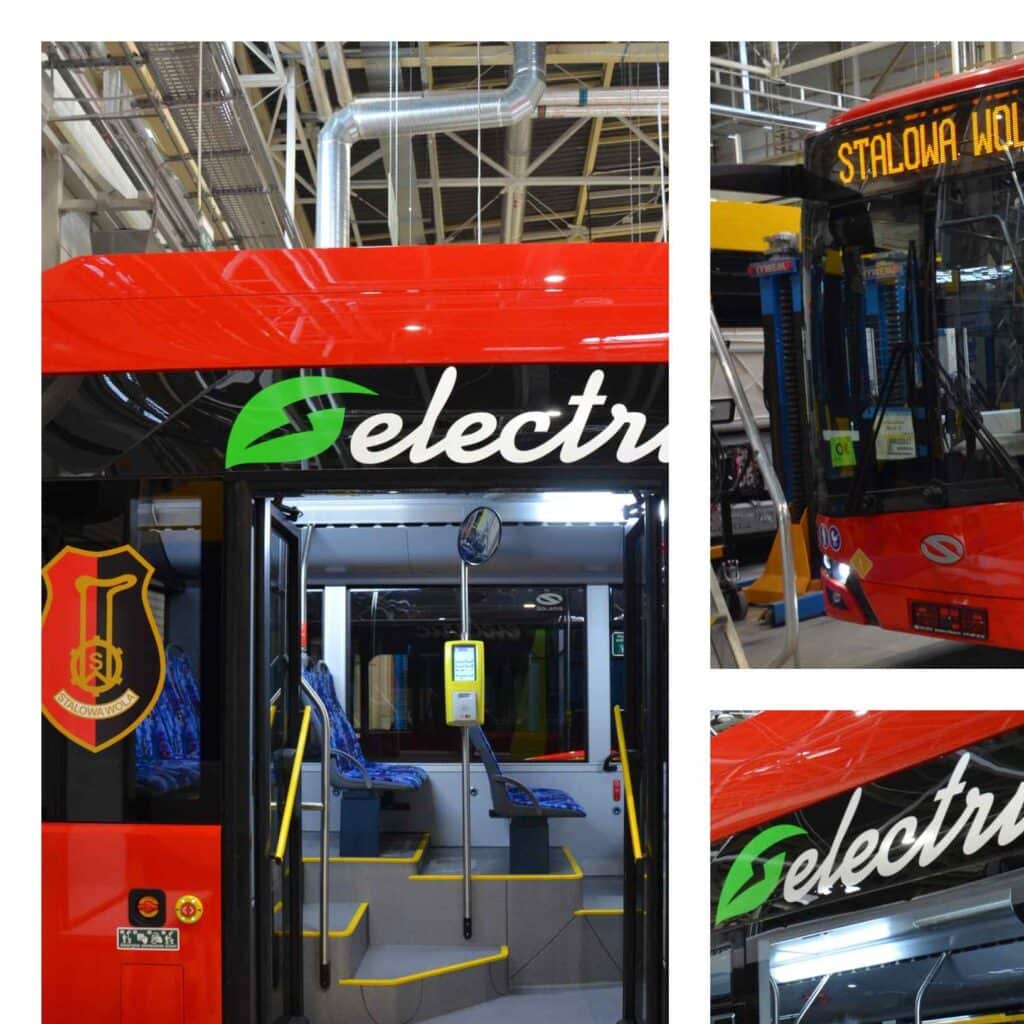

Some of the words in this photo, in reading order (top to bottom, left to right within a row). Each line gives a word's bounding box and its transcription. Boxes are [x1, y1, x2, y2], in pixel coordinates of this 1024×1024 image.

[837, 117, 957, 185] STALOWA
[57, 692, 104, 716] STALOWA
[105, 693, 136, 715] WOLA
